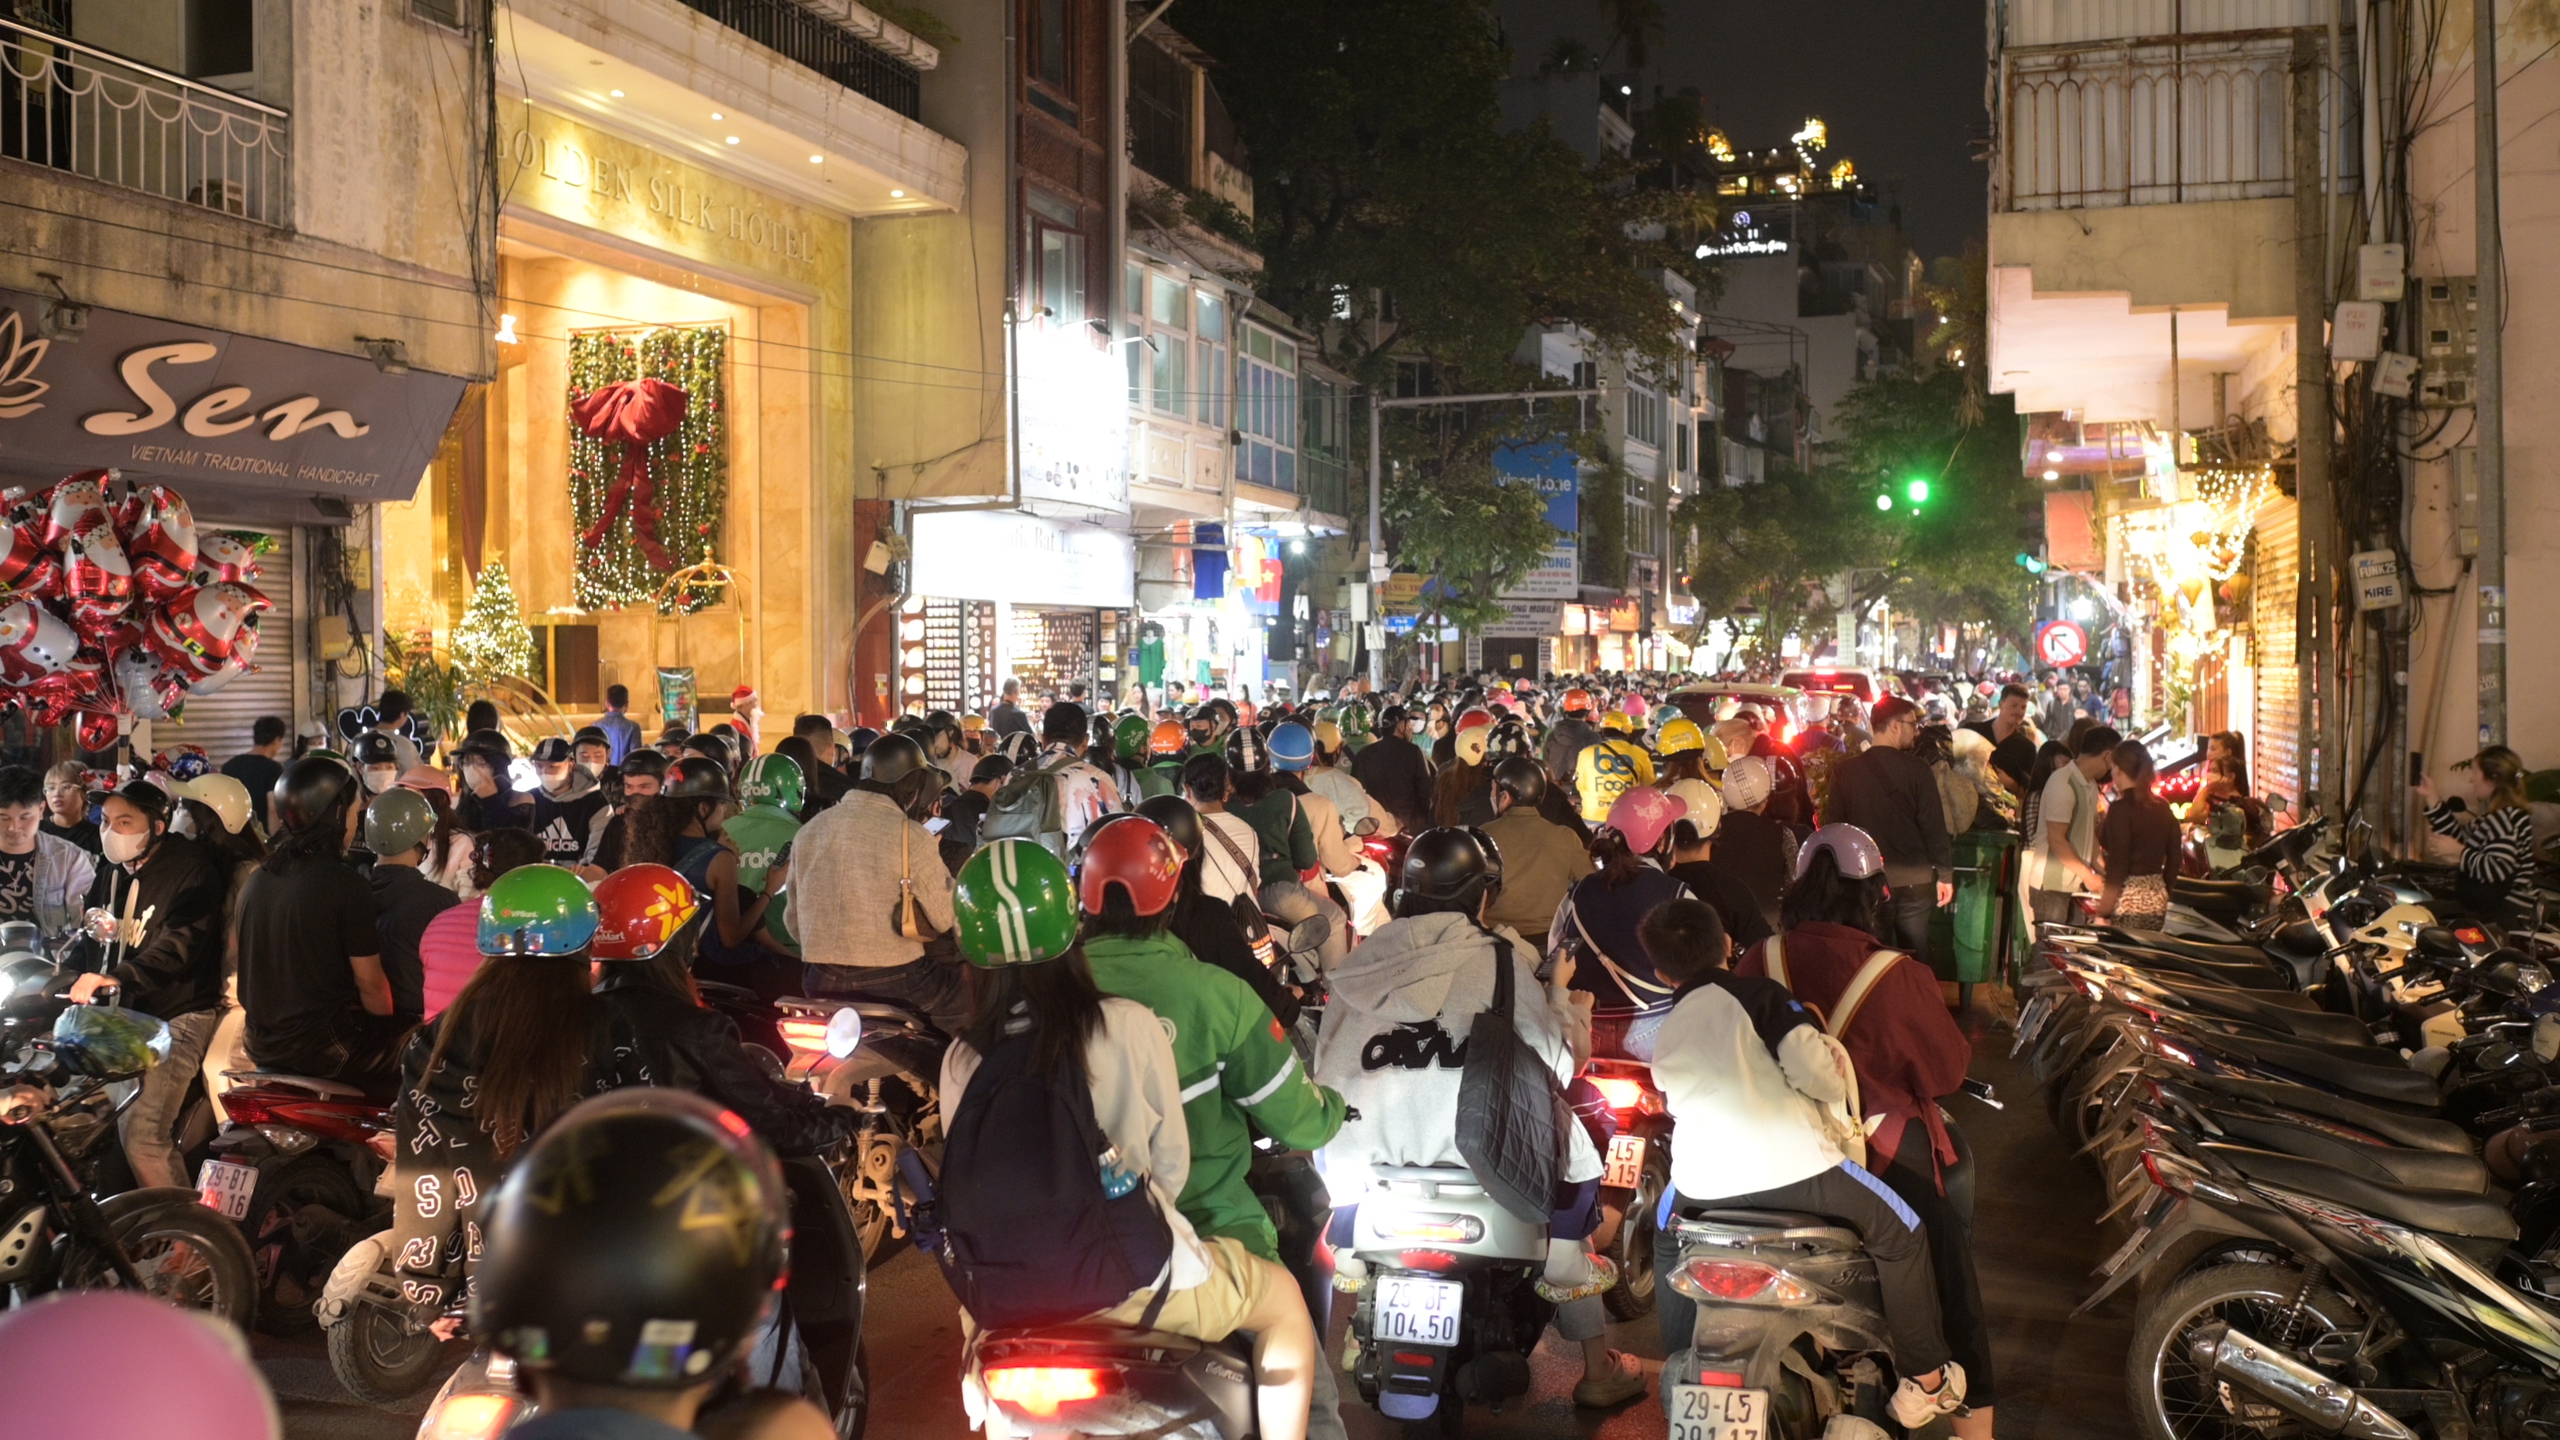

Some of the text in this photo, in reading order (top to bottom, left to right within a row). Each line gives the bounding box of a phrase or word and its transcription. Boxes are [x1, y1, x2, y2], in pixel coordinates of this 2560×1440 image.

[497, 120, 815, 264] GOLDEN SILK HOTEL
[79, 341, 371, 442] Sen
[130, 444, 380, 488] VIETNAM TRADITIONAL HANDICRAFT
[1034, 526, 1055, 552] Bat
[1541, 557, 1572, 569] LONG
[2359, 562, 2397, 579] FUNK25
[2364, 586, 2394, 599] KIRE
[1507, 604, 1527, 614] LONG
[1129, 730, 1145, 747] Grab
[1594, 747, 1635, 775] be
[741, 783, 771, 798] Grab
[736, 847, 777, 869] rab
[593, 931, 625, 942] inMart
[2431, 1029, 2457, 1037] HONDA
[206, 1164, 250, 1192] 29-B1
[1382, 1310, 1454, 1341] 104.50
[1683, 1390, 1752, 1424] 29-L5
